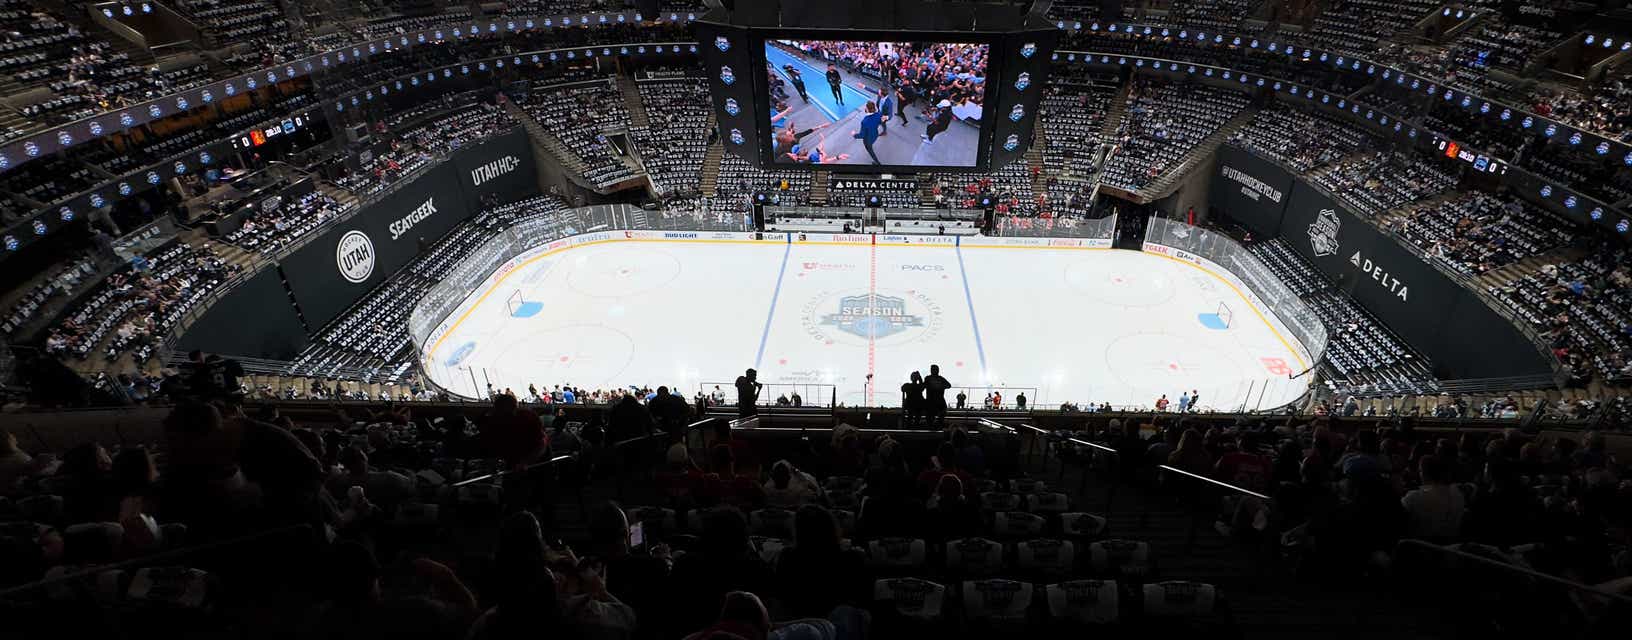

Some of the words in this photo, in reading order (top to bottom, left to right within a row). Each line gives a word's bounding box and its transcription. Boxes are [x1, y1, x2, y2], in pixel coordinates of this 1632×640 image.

[471, 161, 500, 186] UTAH
[389, 197, 437, 240] SEATGEEK
[343, 244, 370, 271] UTAH
[1362, 259, 1408, 301] DELTA
[842, 306, 904, 316] SEASON
